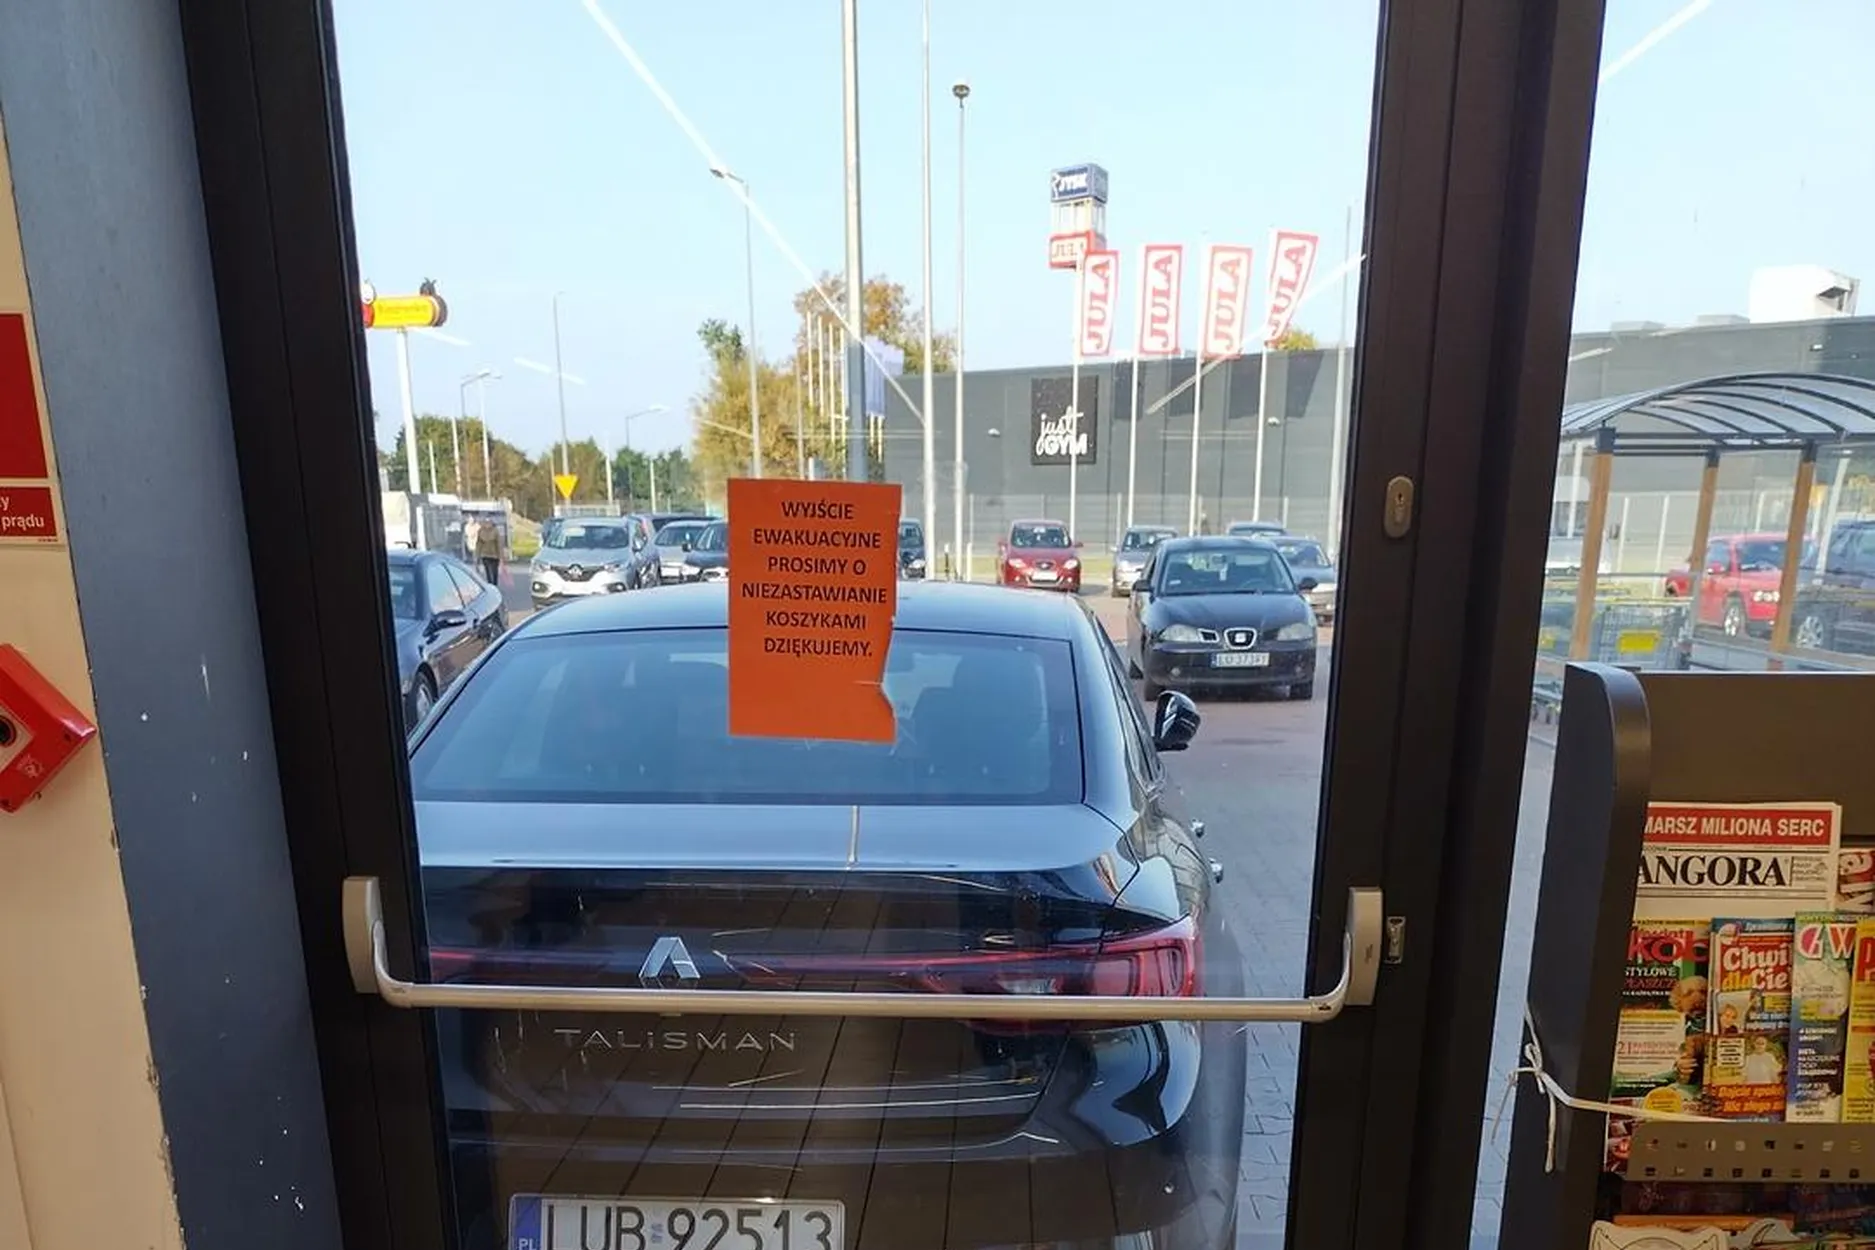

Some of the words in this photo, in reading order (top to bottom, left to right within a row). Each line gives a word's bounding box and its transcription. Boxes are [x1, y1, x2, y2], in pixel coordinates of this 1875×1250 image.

[1149, 254, 1174, 347] JULA
[1215, 256, 1242, 351] JULA
[1267, 245, 1306, 341] JULA
[1086, 258, 1112, 350] JULA
[1036, 405, 1084, 455] just
[782, 499, 854, 519] WYJŚCIE
[2, 514, 45, 531] prądu
[754, 528, 881, 549] EWAKUACYJNE
[768, 556, 847, 575] PROSIMY
[853, 559, 866, 576] O
[742, 583, 887, 604] NIEZASTAWIANIE
[766, 610, 867, 630] KOSZYKAMI
[764, 637, 872, 658] DZIĘKUJEMY.
[1701, 817, 1773, 836] MILIONA
[1777, 818, 1825, 837] SERC
[1638, 855, 1787, 887] ANGORA
[1721, 971, 1752, 991] dla
[554, 1029, 796, 1051] TALISMAN
